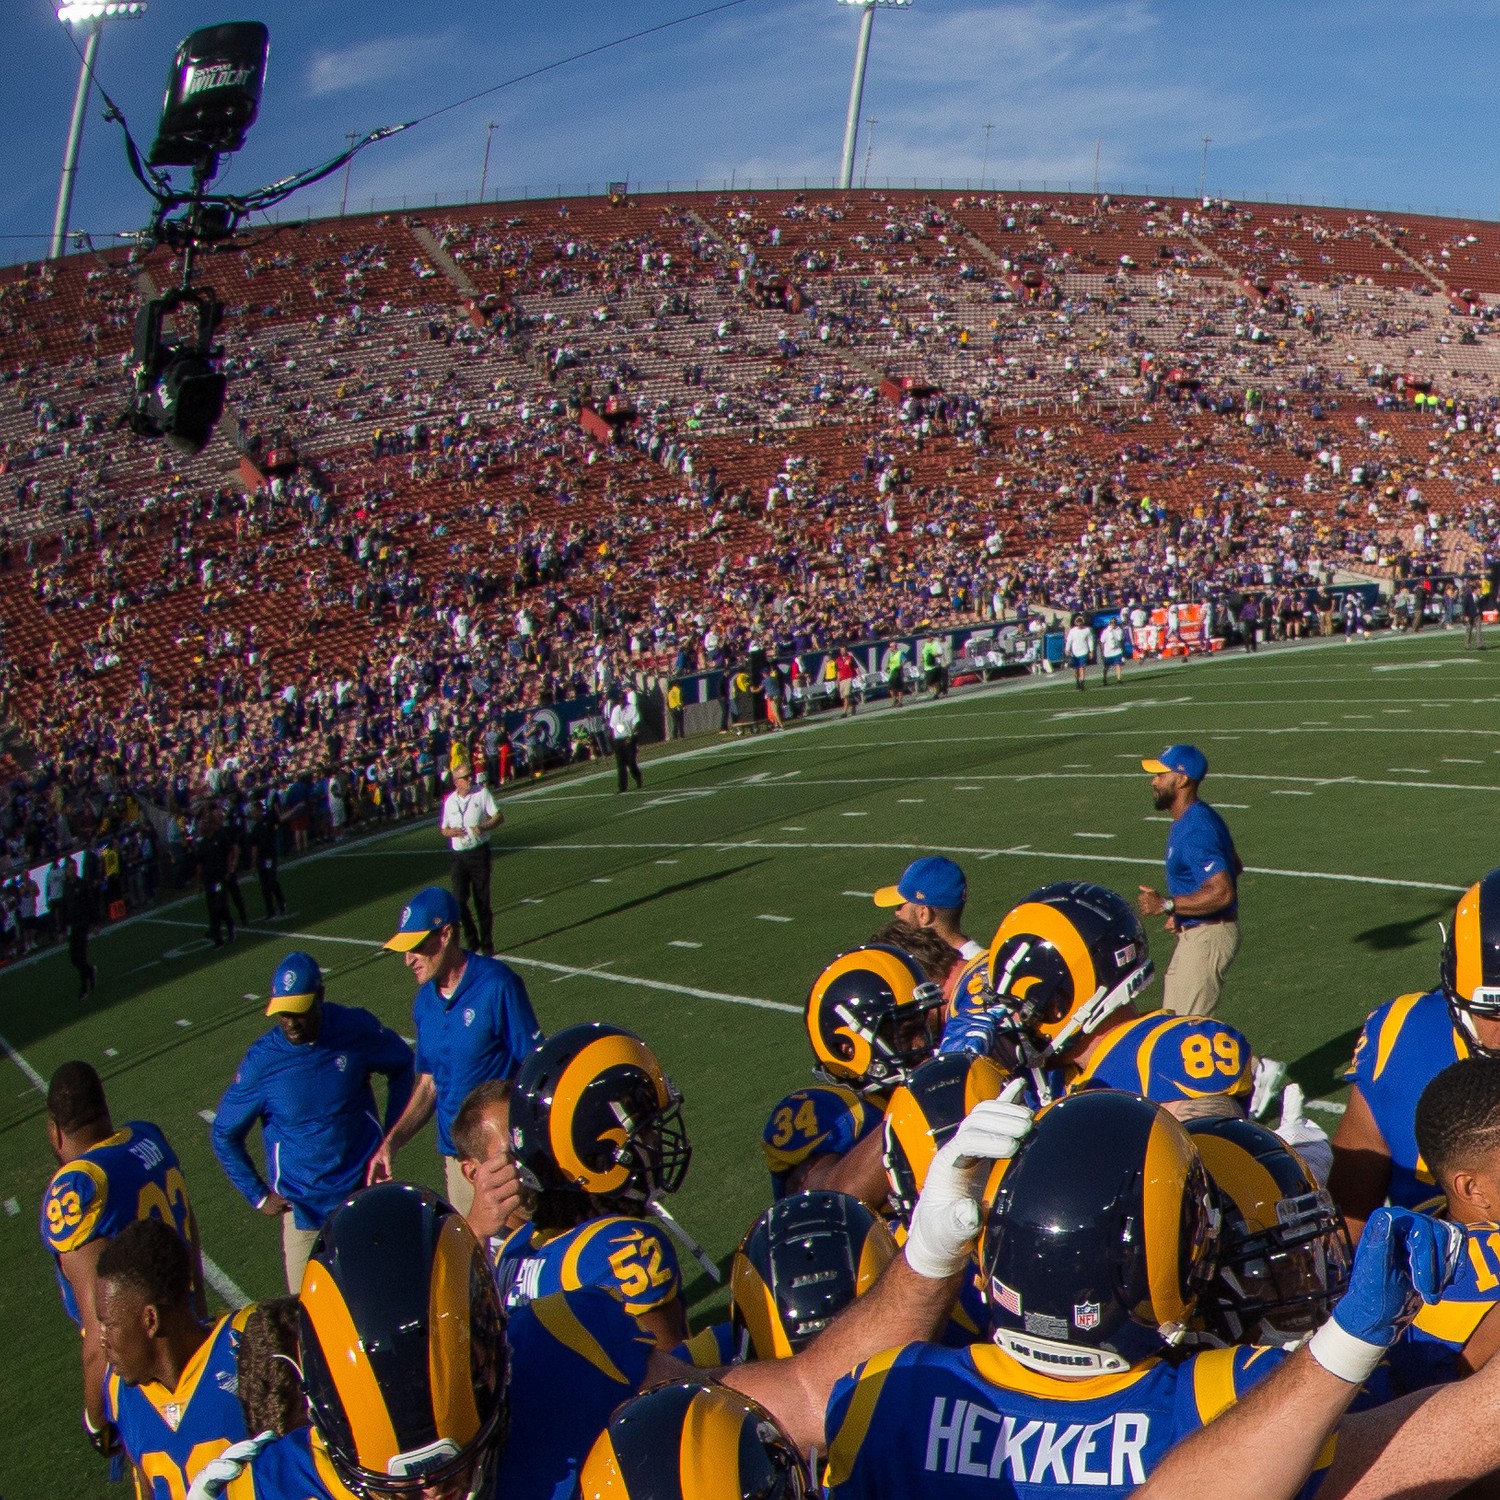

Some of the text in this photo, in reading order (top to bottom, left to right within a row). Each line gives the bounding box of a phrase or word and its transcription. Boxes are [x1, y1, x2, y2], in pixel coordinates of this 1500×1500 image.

[190, 68, 255, 92] WILDCAT
[1180, 1032, 1240, 1079] 89
[771, 1101, 818, 1148] 34
[129, 1138, 164, 1171] SUH
[46, 1193, 84, 1234] 93
[608, 1244, 674, 1298] 52
[1009, 1340, 1094, 1368] LOS ANGELES
[925, 1396, 1149, 1487] HEKKER
